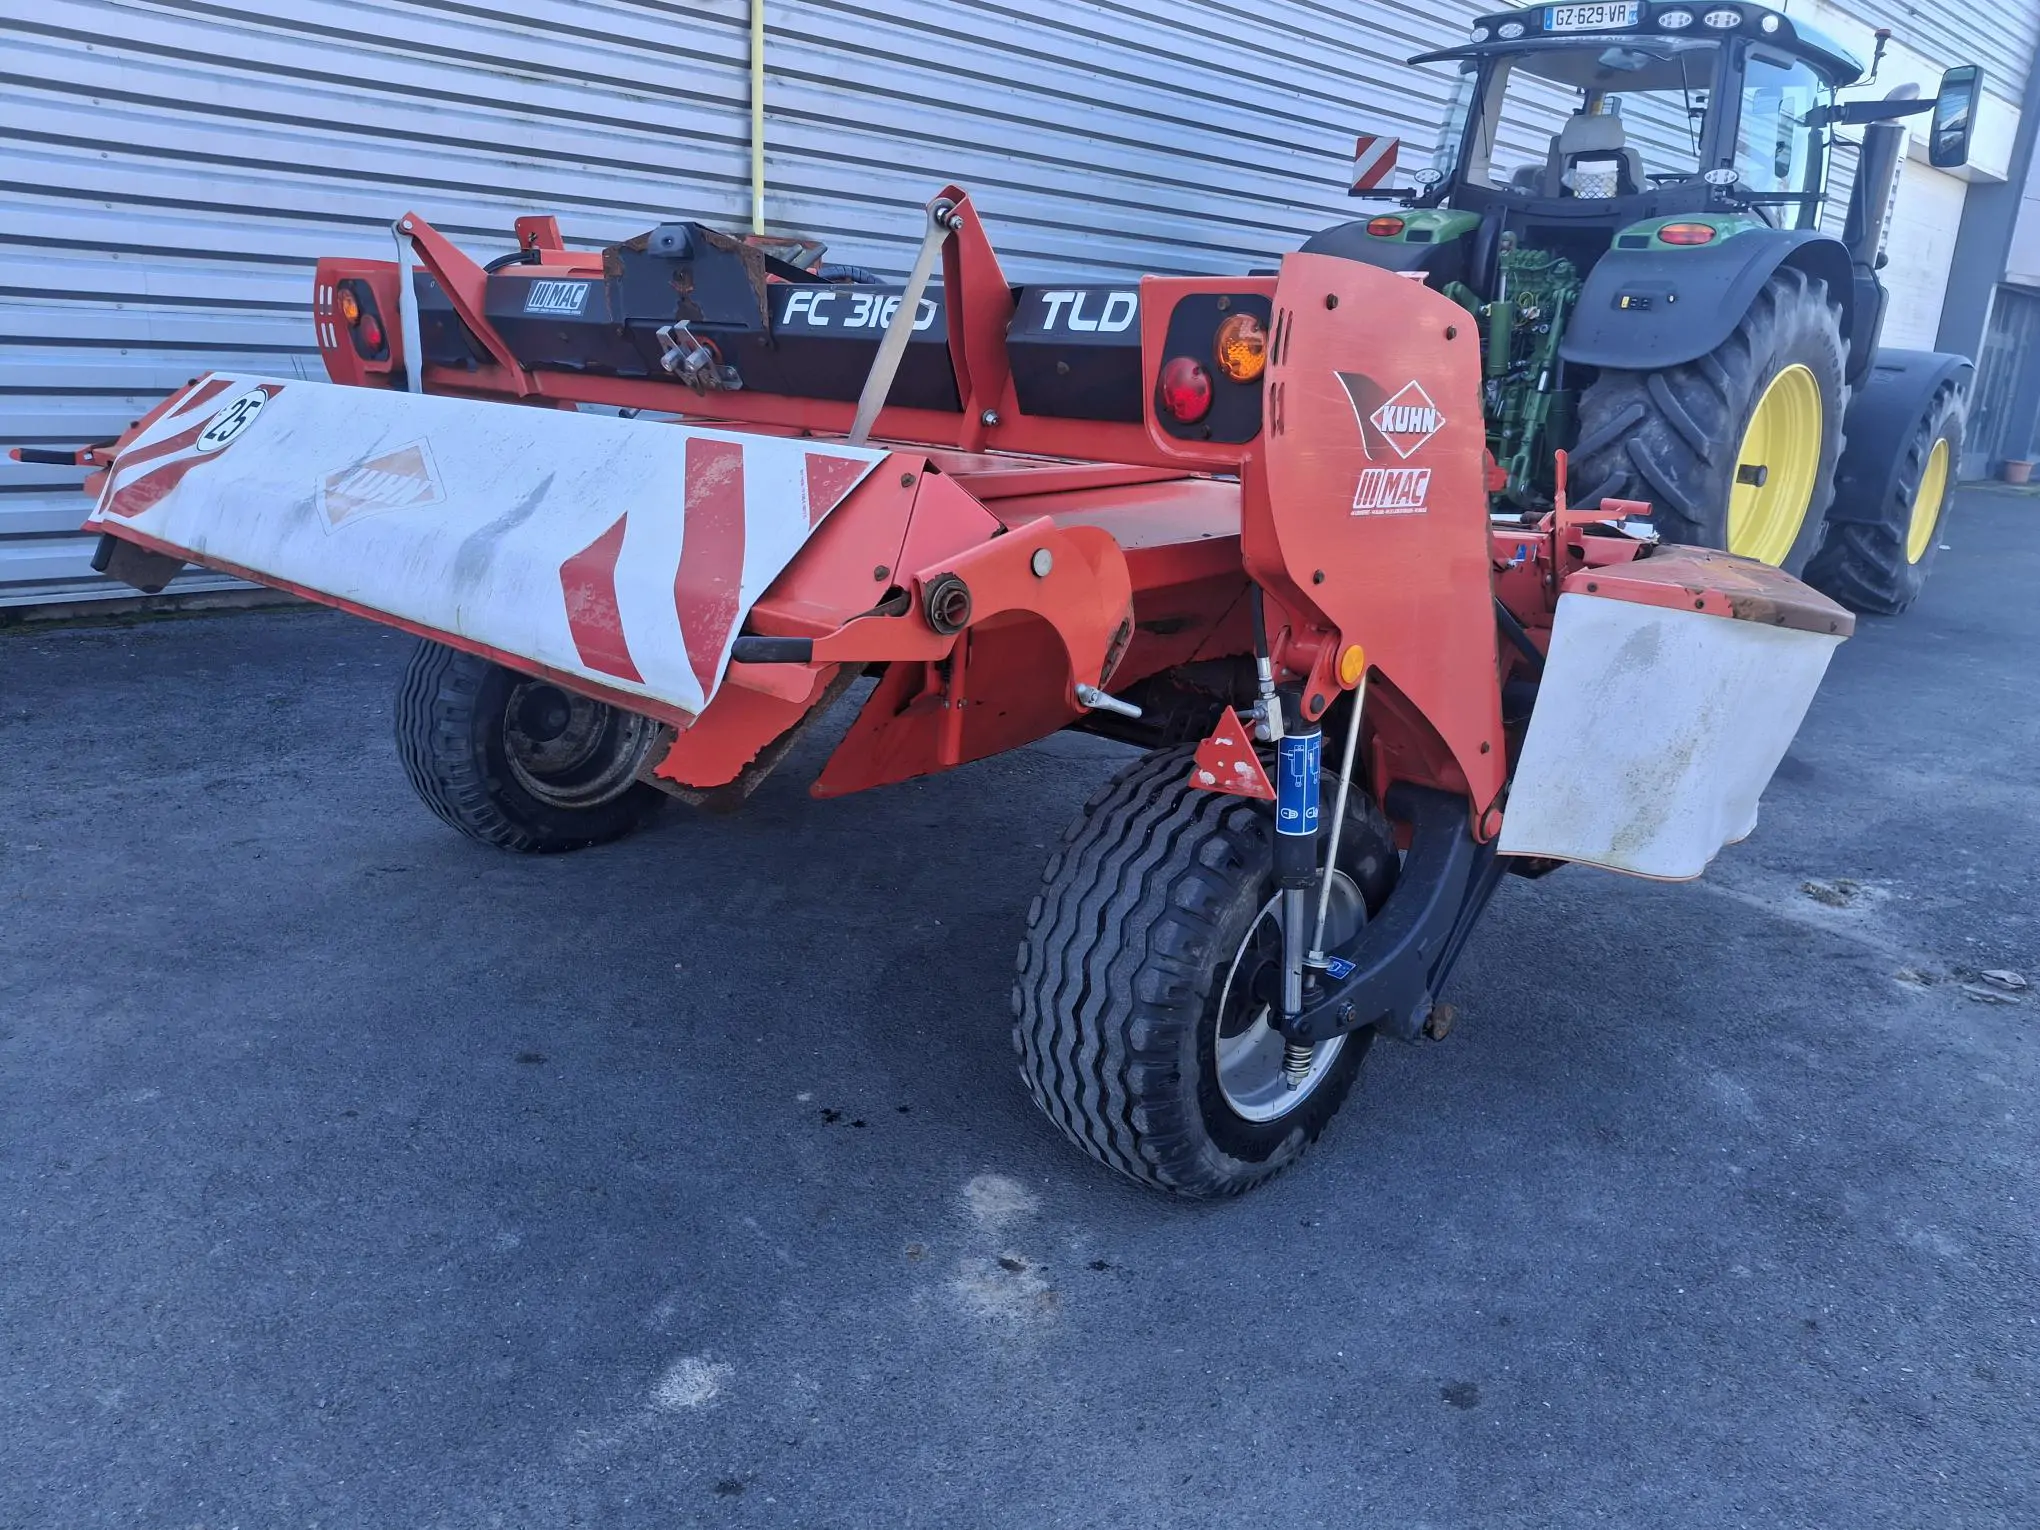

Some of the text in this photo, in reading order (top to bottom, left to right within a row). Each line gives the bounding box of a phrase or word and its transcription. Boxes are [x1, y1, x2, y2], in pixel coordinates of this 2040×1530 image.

[783, 291, 836, 326] FC
[1041, 291, 1138, 332] TLD
[204, 398, 262, 442] 25
[1381, 405, 1436, 433] KUHN
